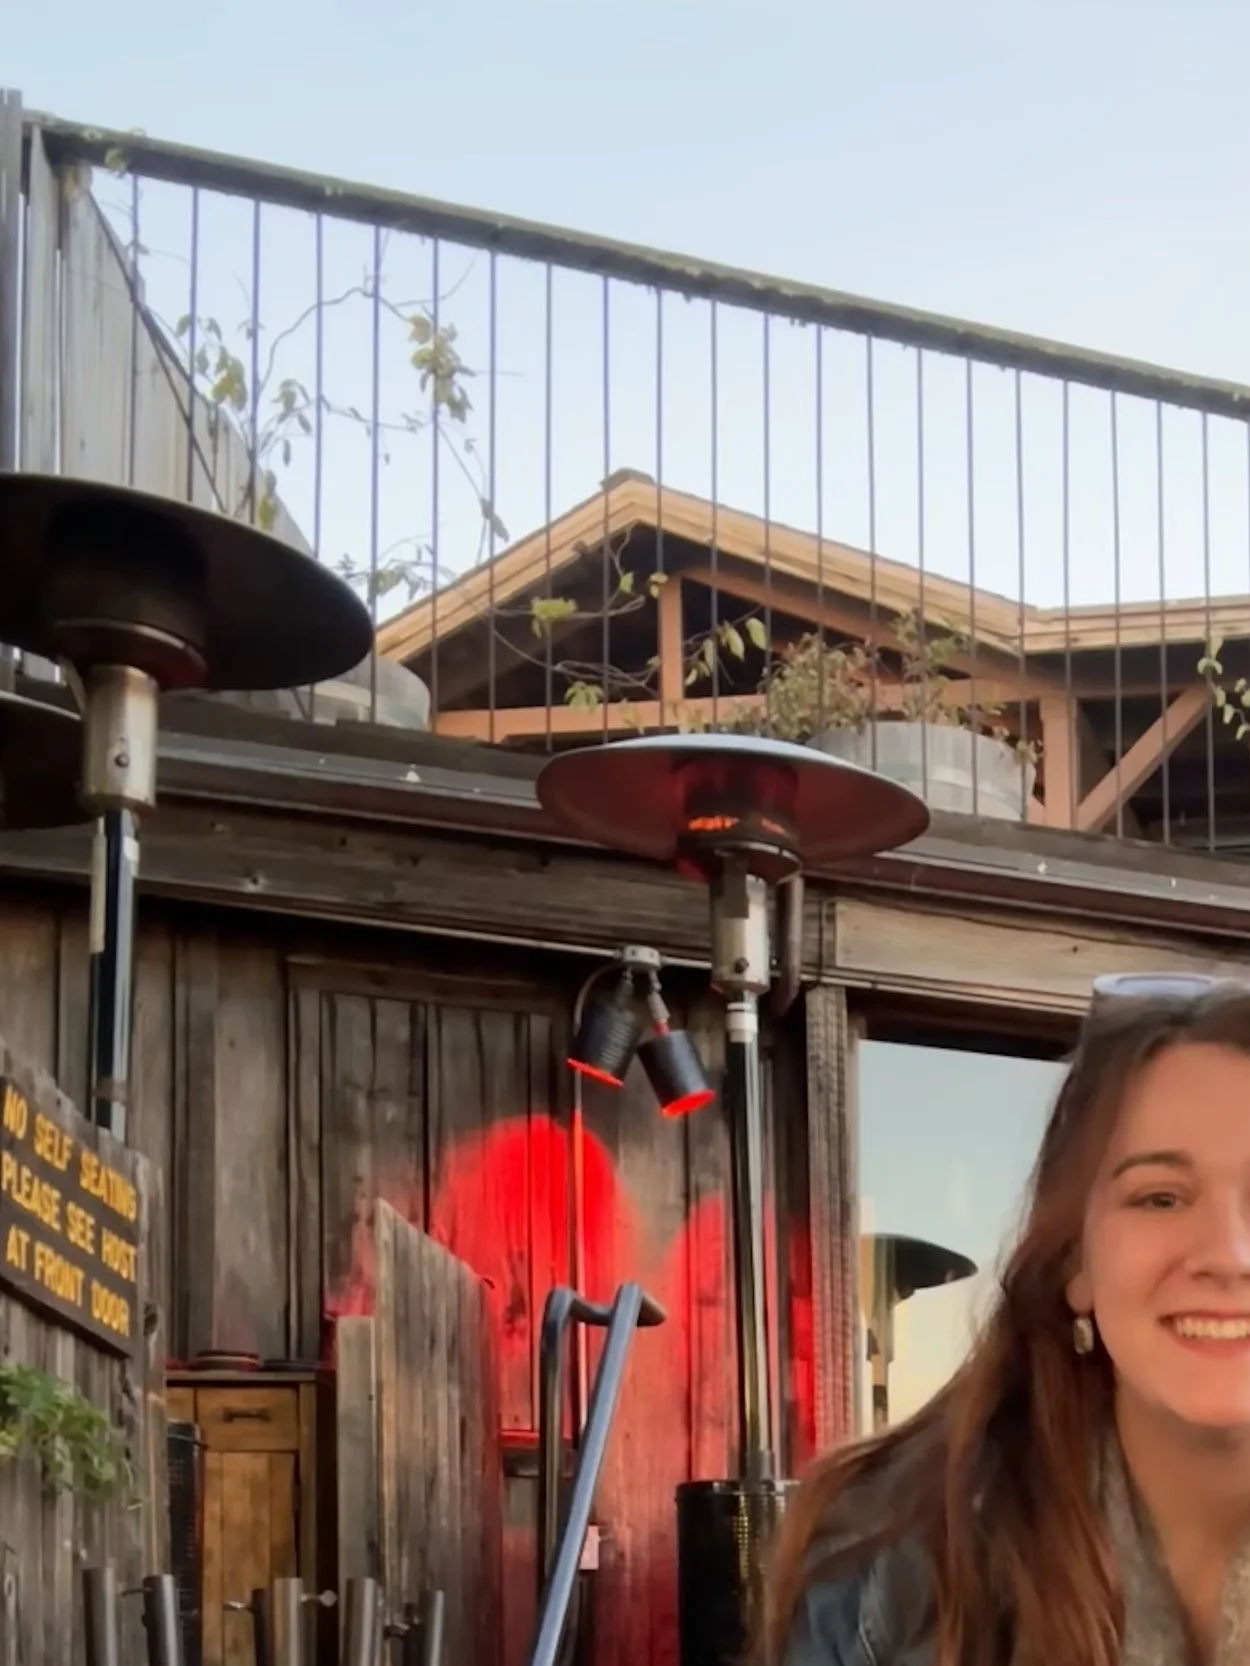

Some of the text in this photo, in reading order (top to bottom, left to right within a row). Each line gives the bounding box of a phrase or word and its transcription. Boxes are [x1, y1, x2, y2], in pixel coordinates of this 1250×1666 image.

[1, 1153, 136, 1282] PLEASE SEE HOST
[3, 1084, 137, 1222] NO SELF SEATING
[6, 1224, 130, 1337] AT FRONT DOOR
